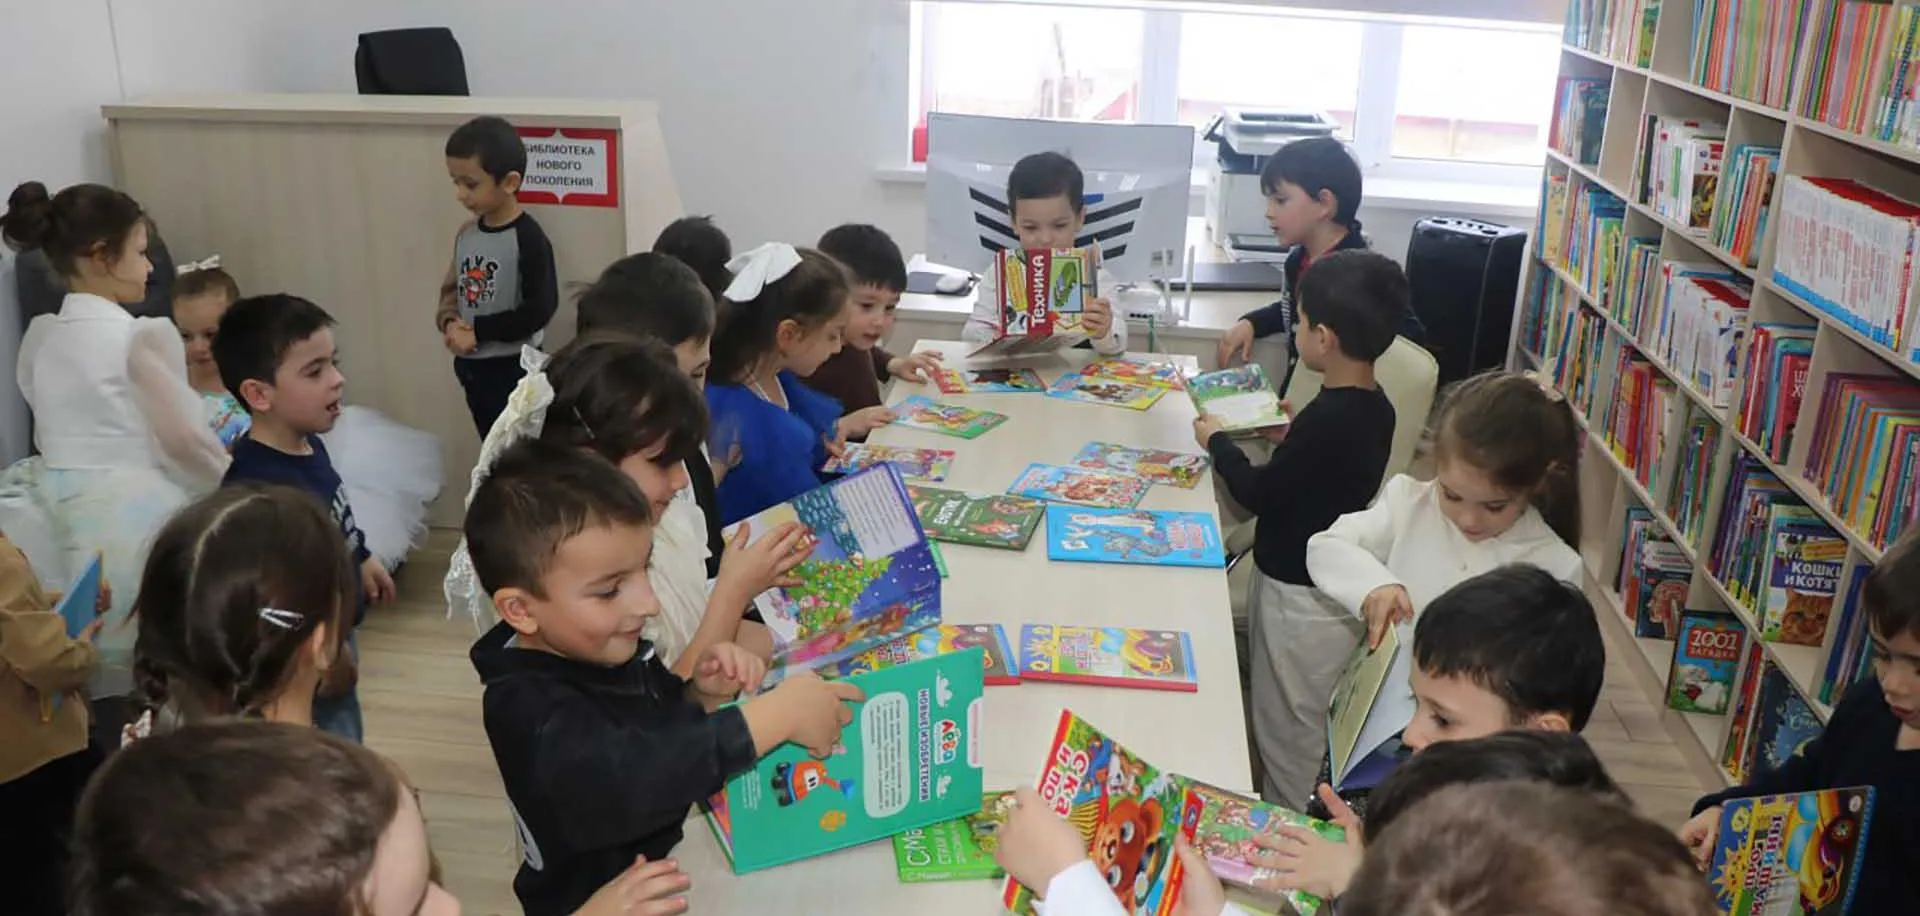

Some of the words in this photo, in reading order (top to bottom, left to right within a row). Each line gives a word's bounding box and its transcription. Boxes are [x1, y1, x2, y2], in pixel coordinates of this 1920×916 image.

[536, 160, 582, 171] НОВОГО
[525, 175, 594, 187] ПОКОЛЕНИЯ
[1691, 630, 1738, 650] 1001
[919, 690, 930, 728] НОВЫЕ
[919, 730, 930, 801] ИЗОБРЕТЕНИЯ
